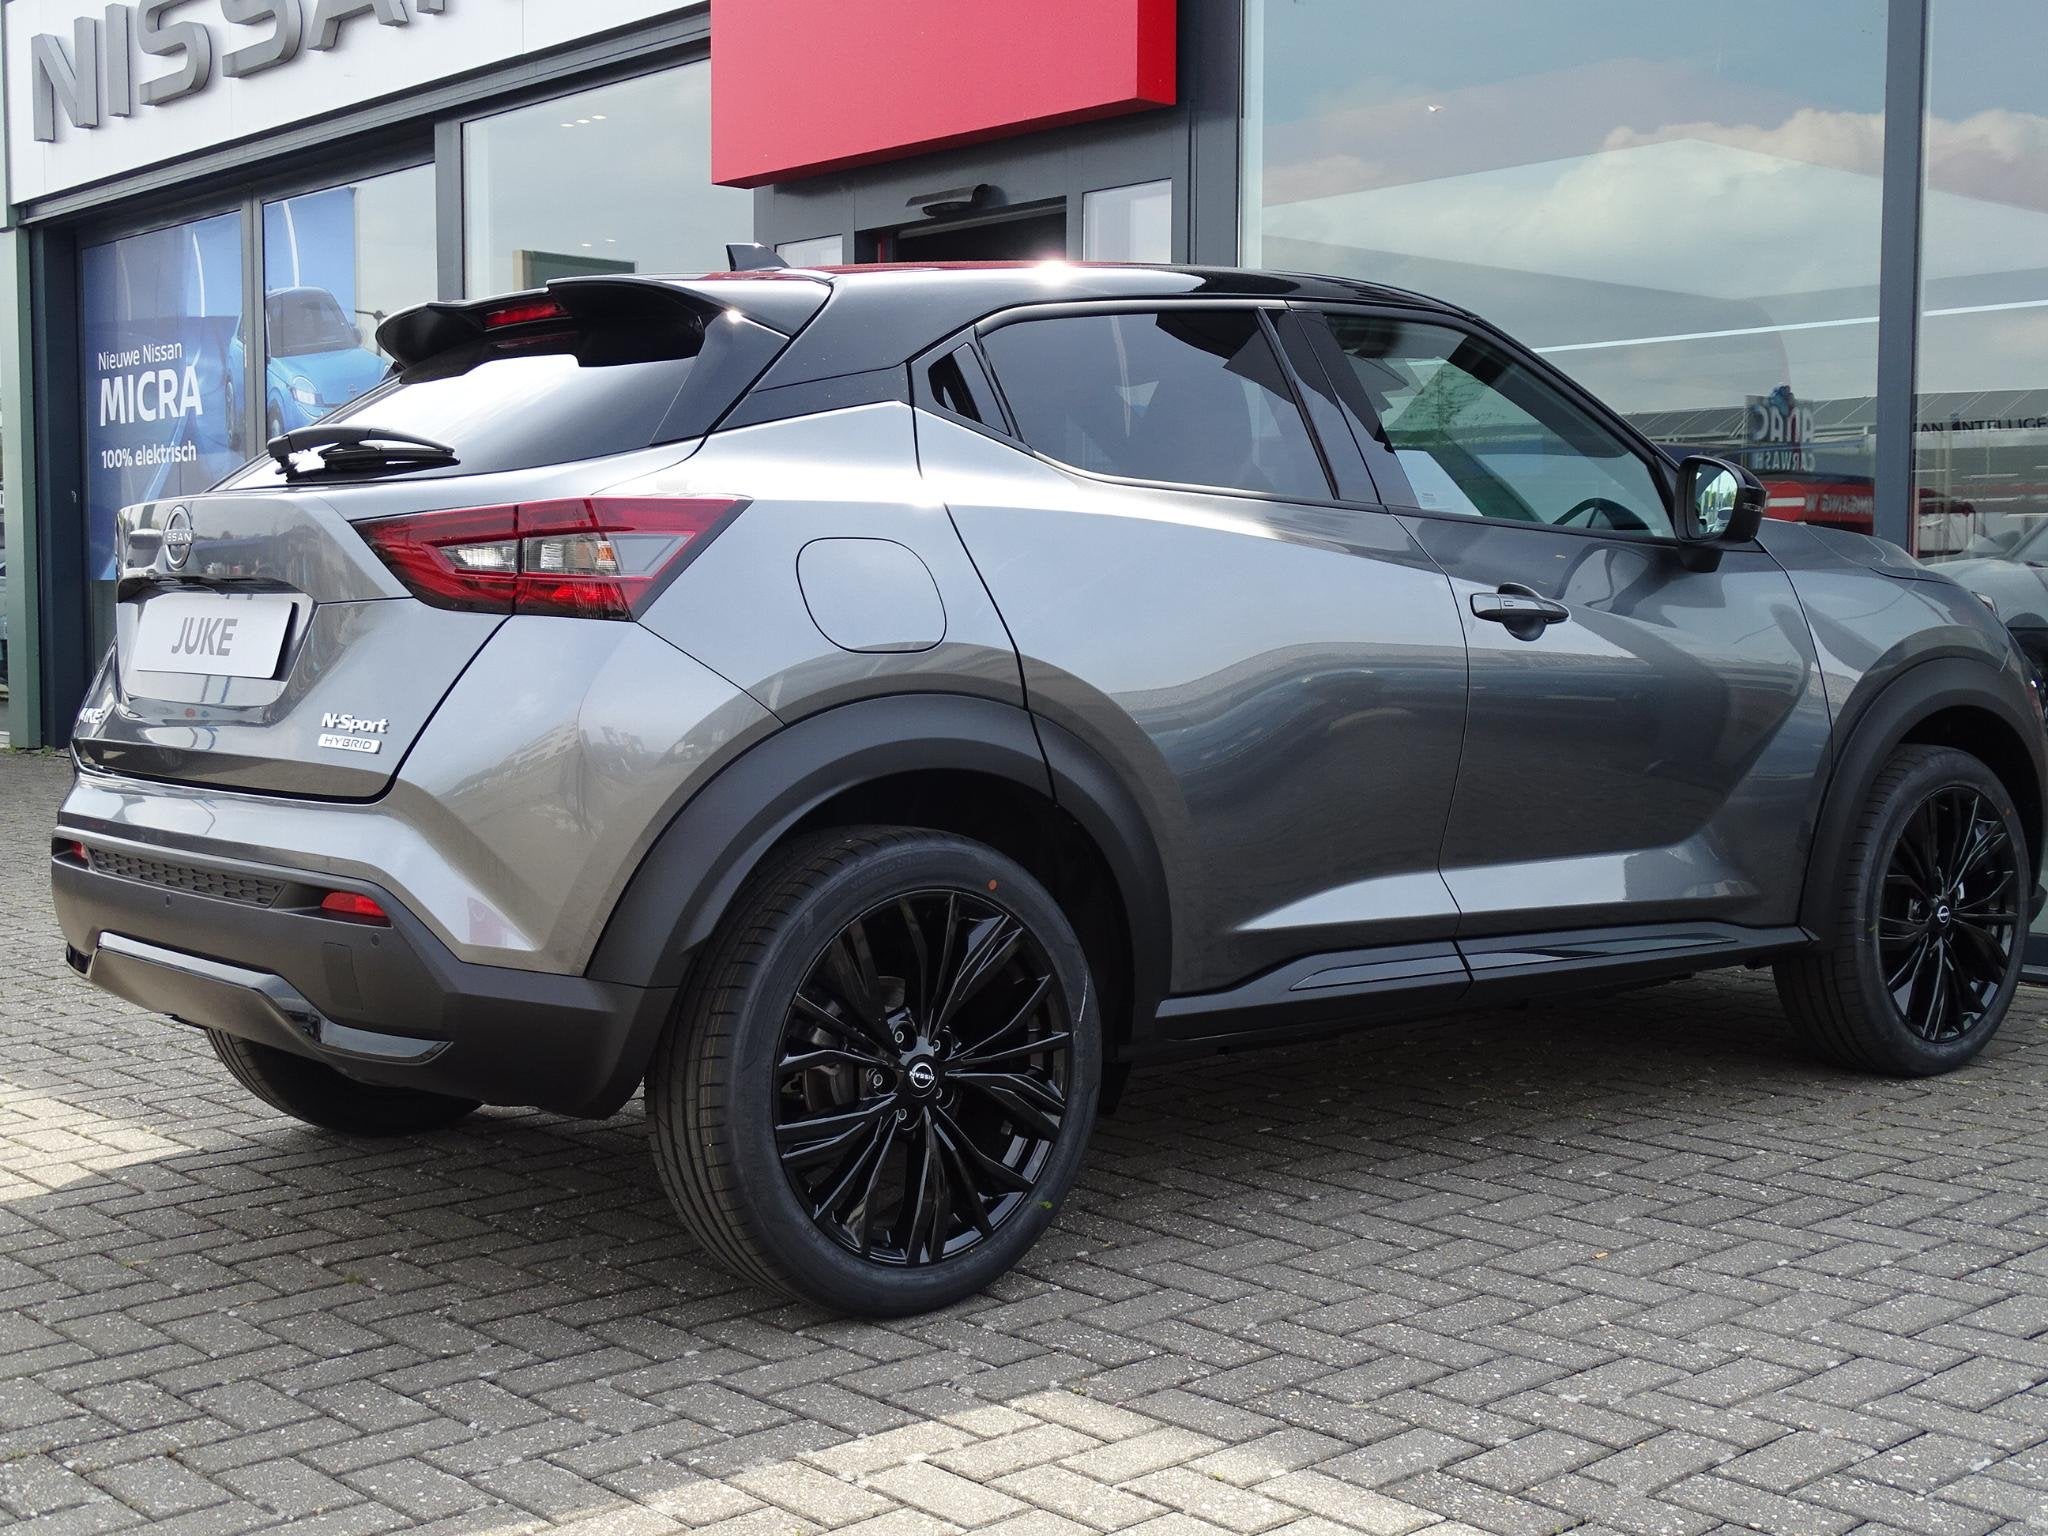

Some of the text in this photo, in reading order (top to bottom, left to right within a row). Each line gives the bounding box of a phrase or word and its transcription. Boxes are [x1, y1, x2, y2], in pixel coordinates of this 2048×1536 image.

[31, 0, 446, 142] NISS
[98, 342, 182, 371] Nieuwe Nissan
[100, 365, 203, 427] MICRA
[101, 440, 197, 469] 100% elektrisch
[171, 616, 239, 657] JUKE
[321, 712, 389, 734] N-Sport
[324, 736, 373, 750] HYBRID
